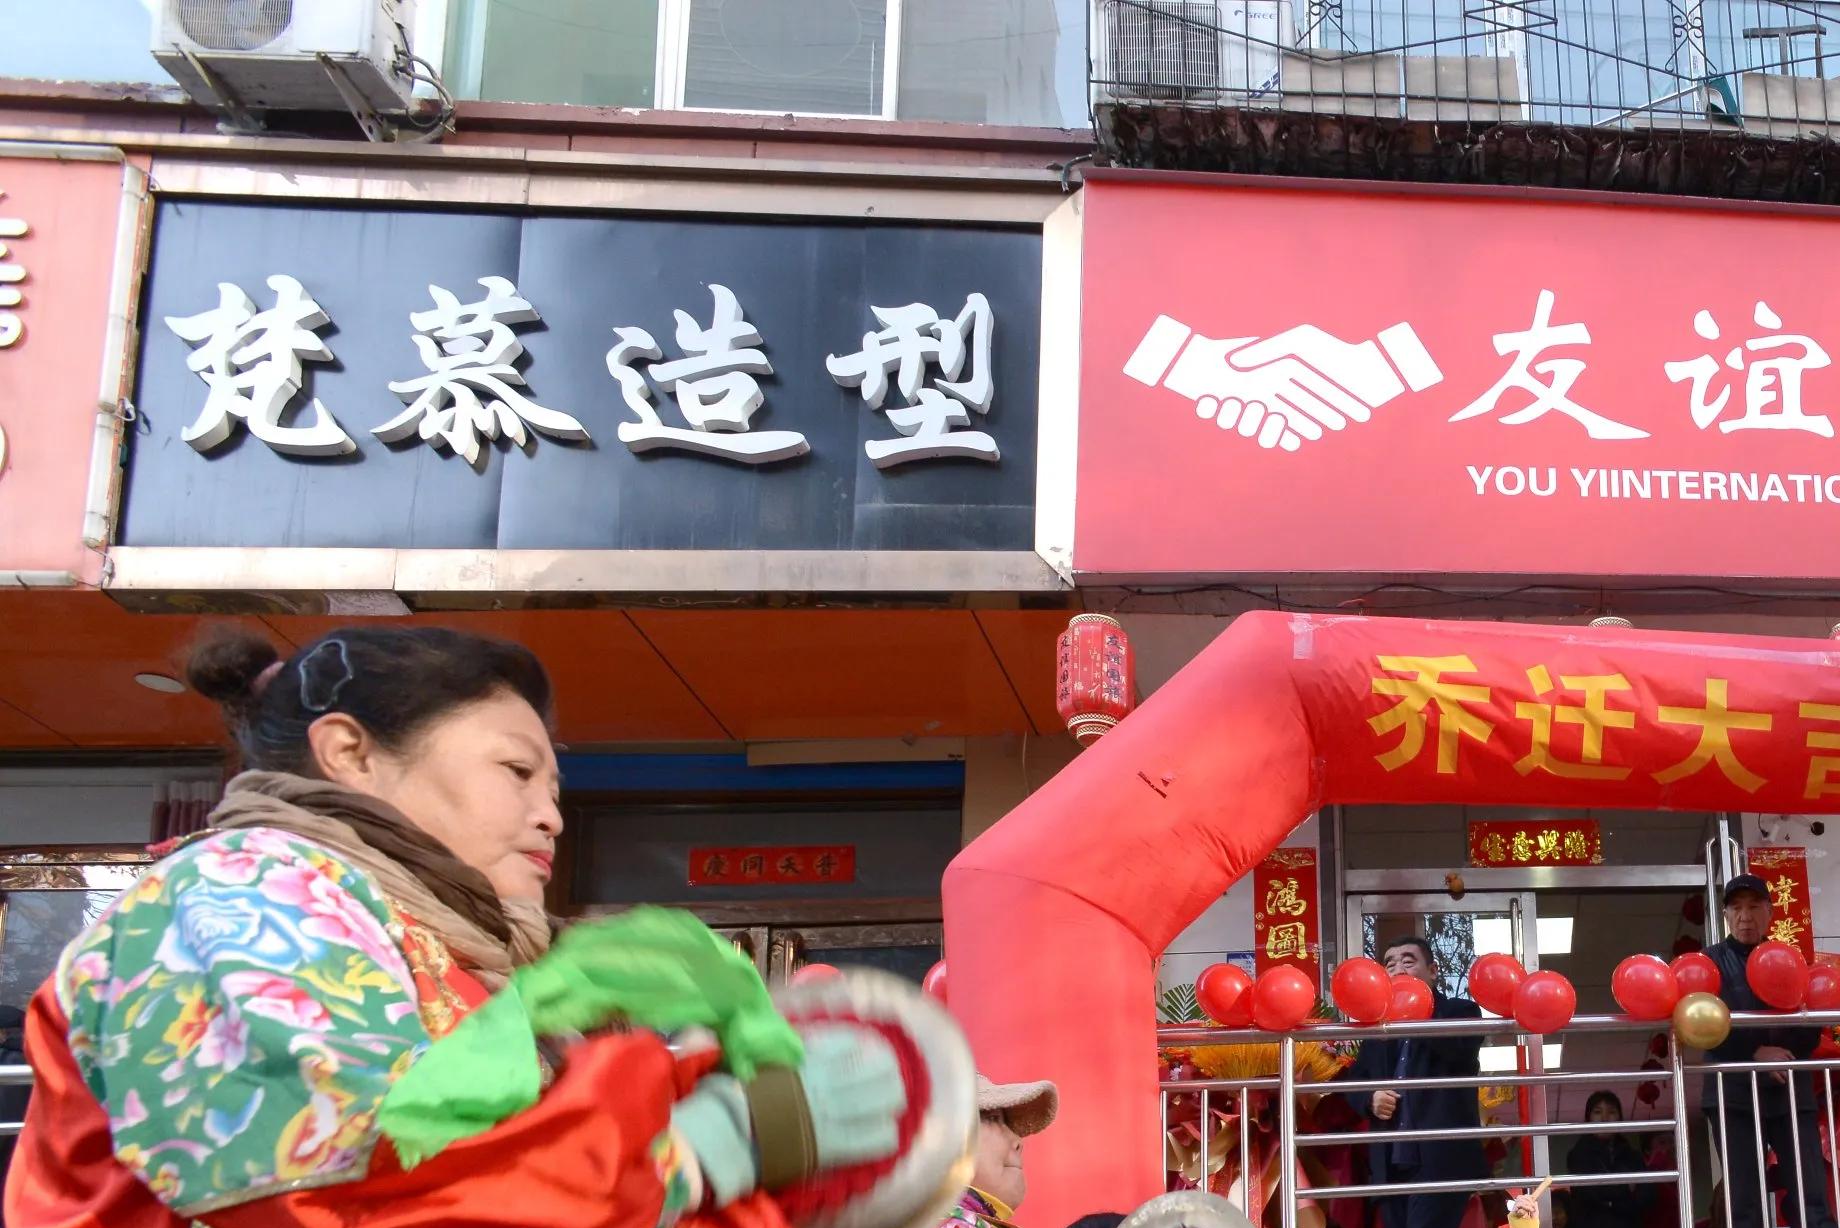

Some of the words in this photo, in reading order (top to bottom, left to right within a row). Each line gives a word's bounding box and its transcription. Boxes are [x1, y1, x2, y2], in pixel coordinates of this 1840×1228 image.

[163, 274, 1000, 470] 梵慕造型
[1466, 465, 1557, 497] YOU
